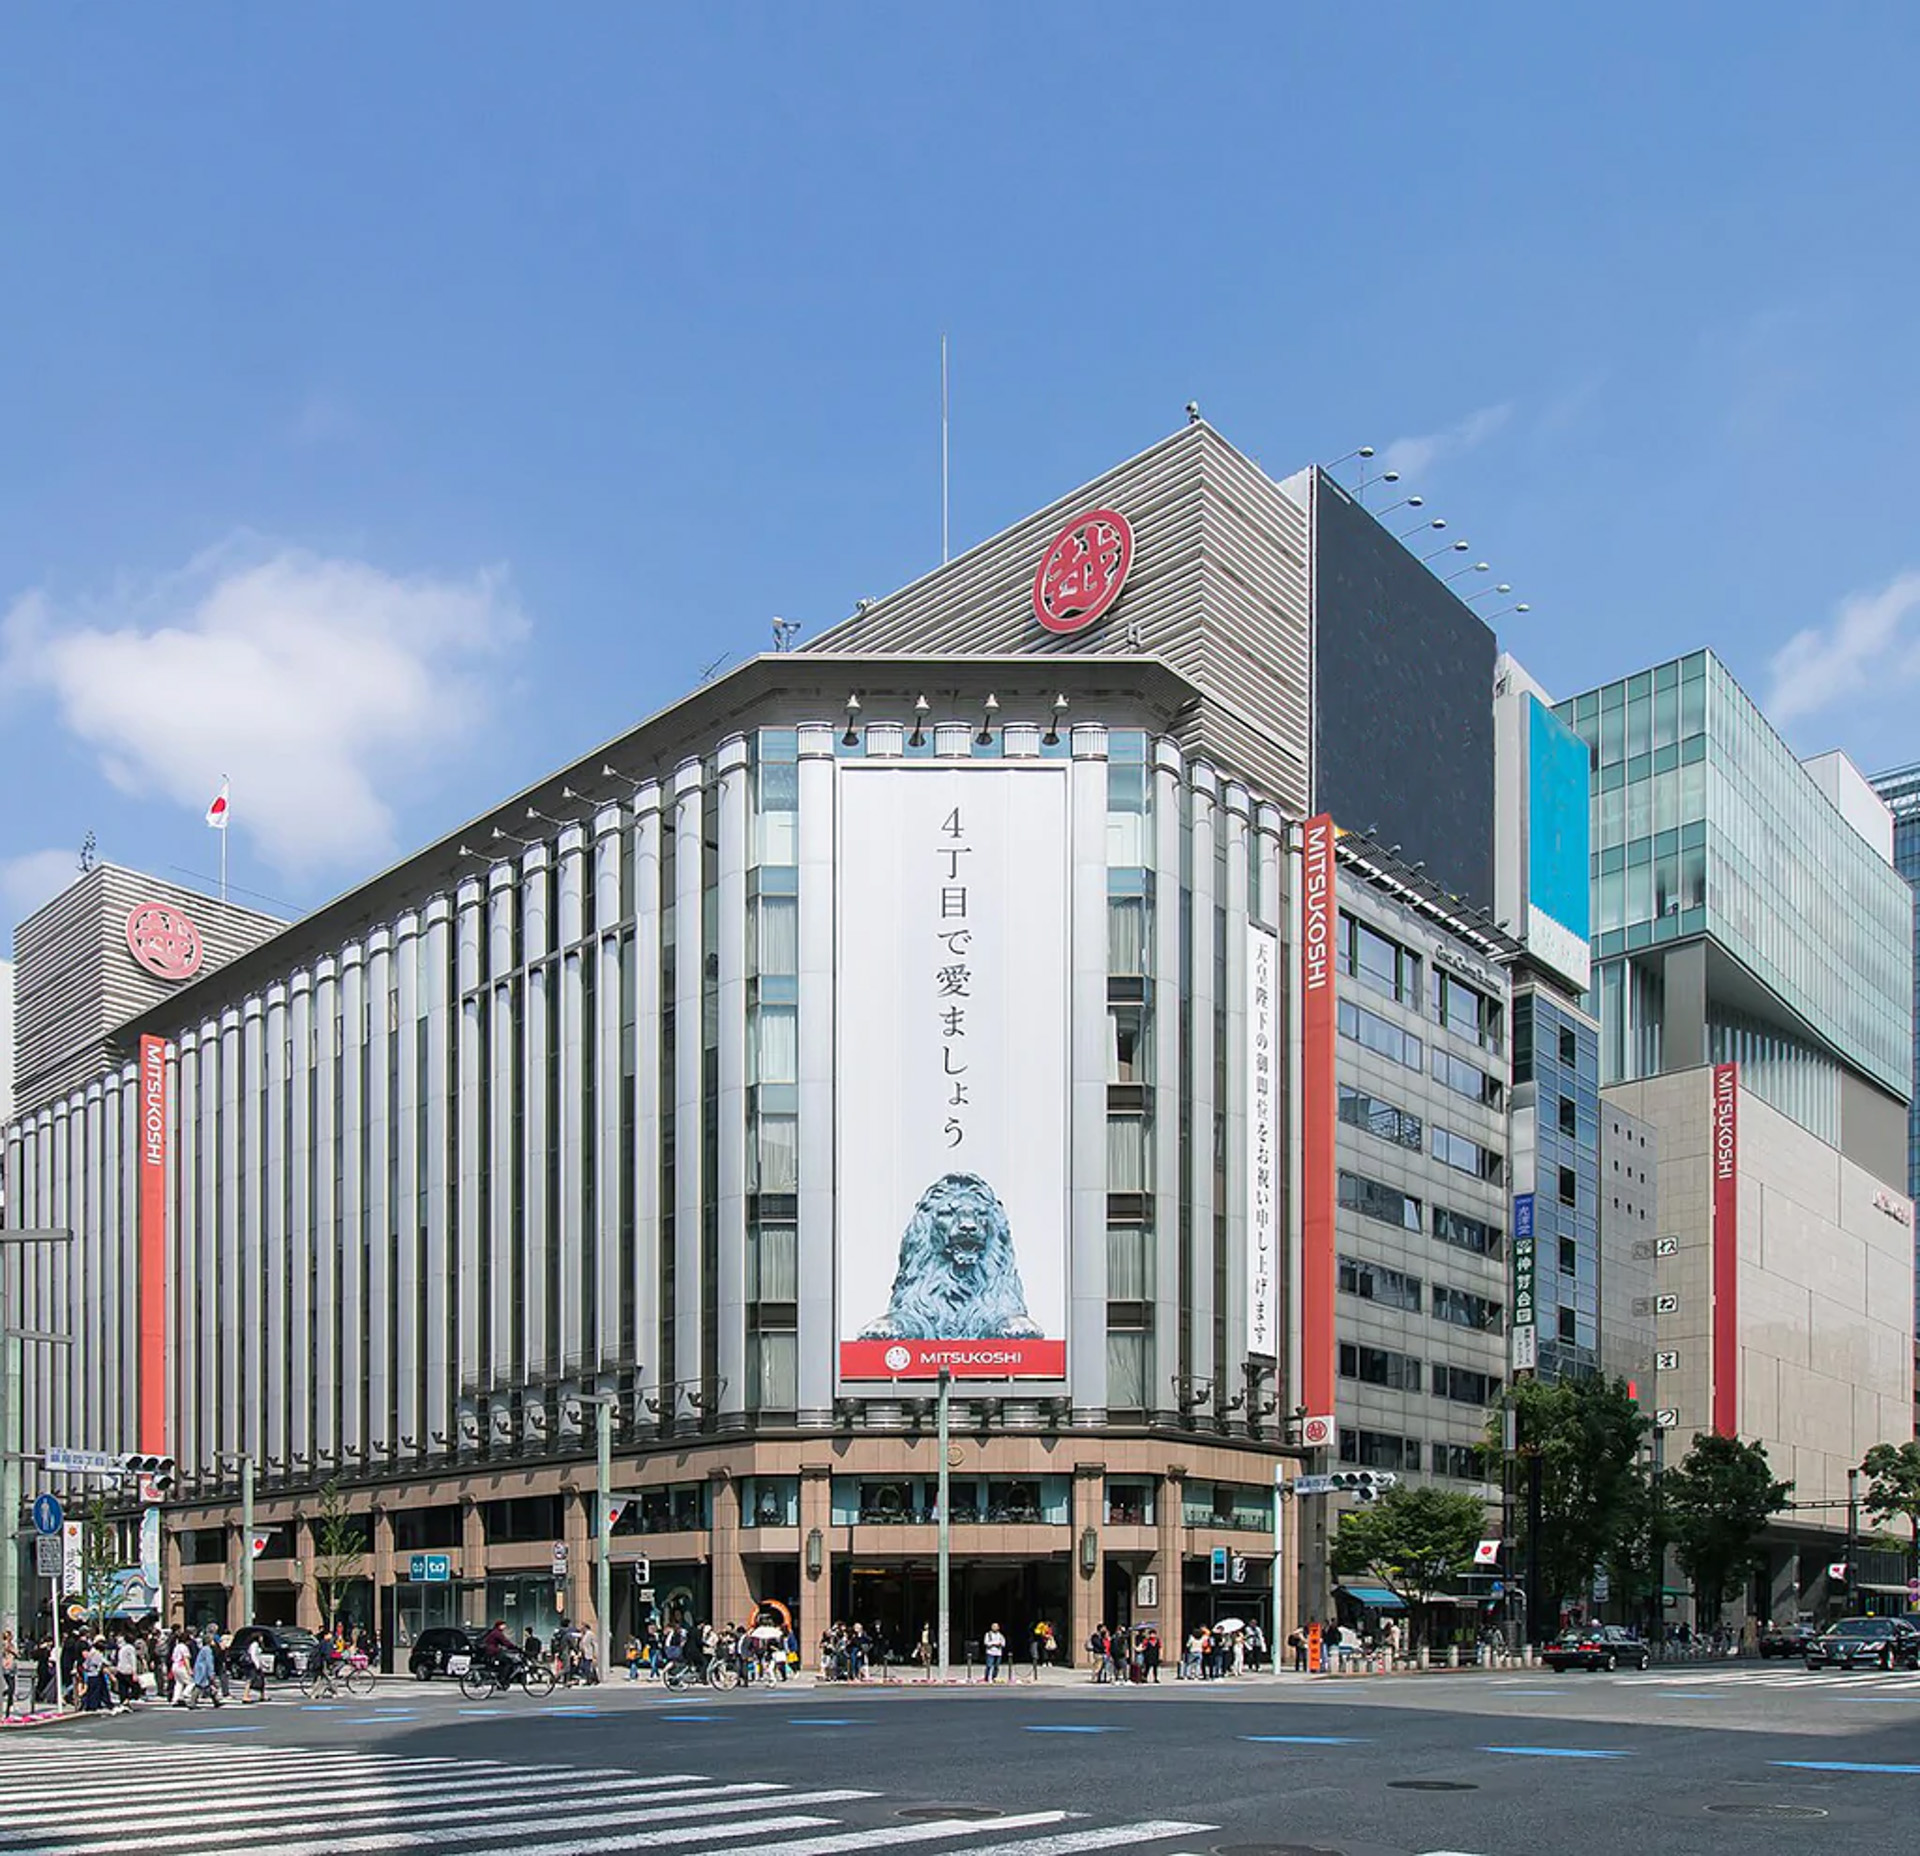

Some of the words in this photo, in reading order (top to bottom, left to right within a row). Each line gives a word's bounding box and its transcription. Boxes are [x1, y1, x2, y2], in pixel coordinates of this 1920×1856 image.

[1307, 825, 1326, 990] MITSUKOSHI
[936, 806, 972, 1149] 4丁目で愛ましょう
[146, 1044, 162, 1166] MITSUKOSHI
[1718, 1070, 1734, 1180] MITSUKOSHI
[920, 1352, 1022, 1364] MITSUKOSHI
